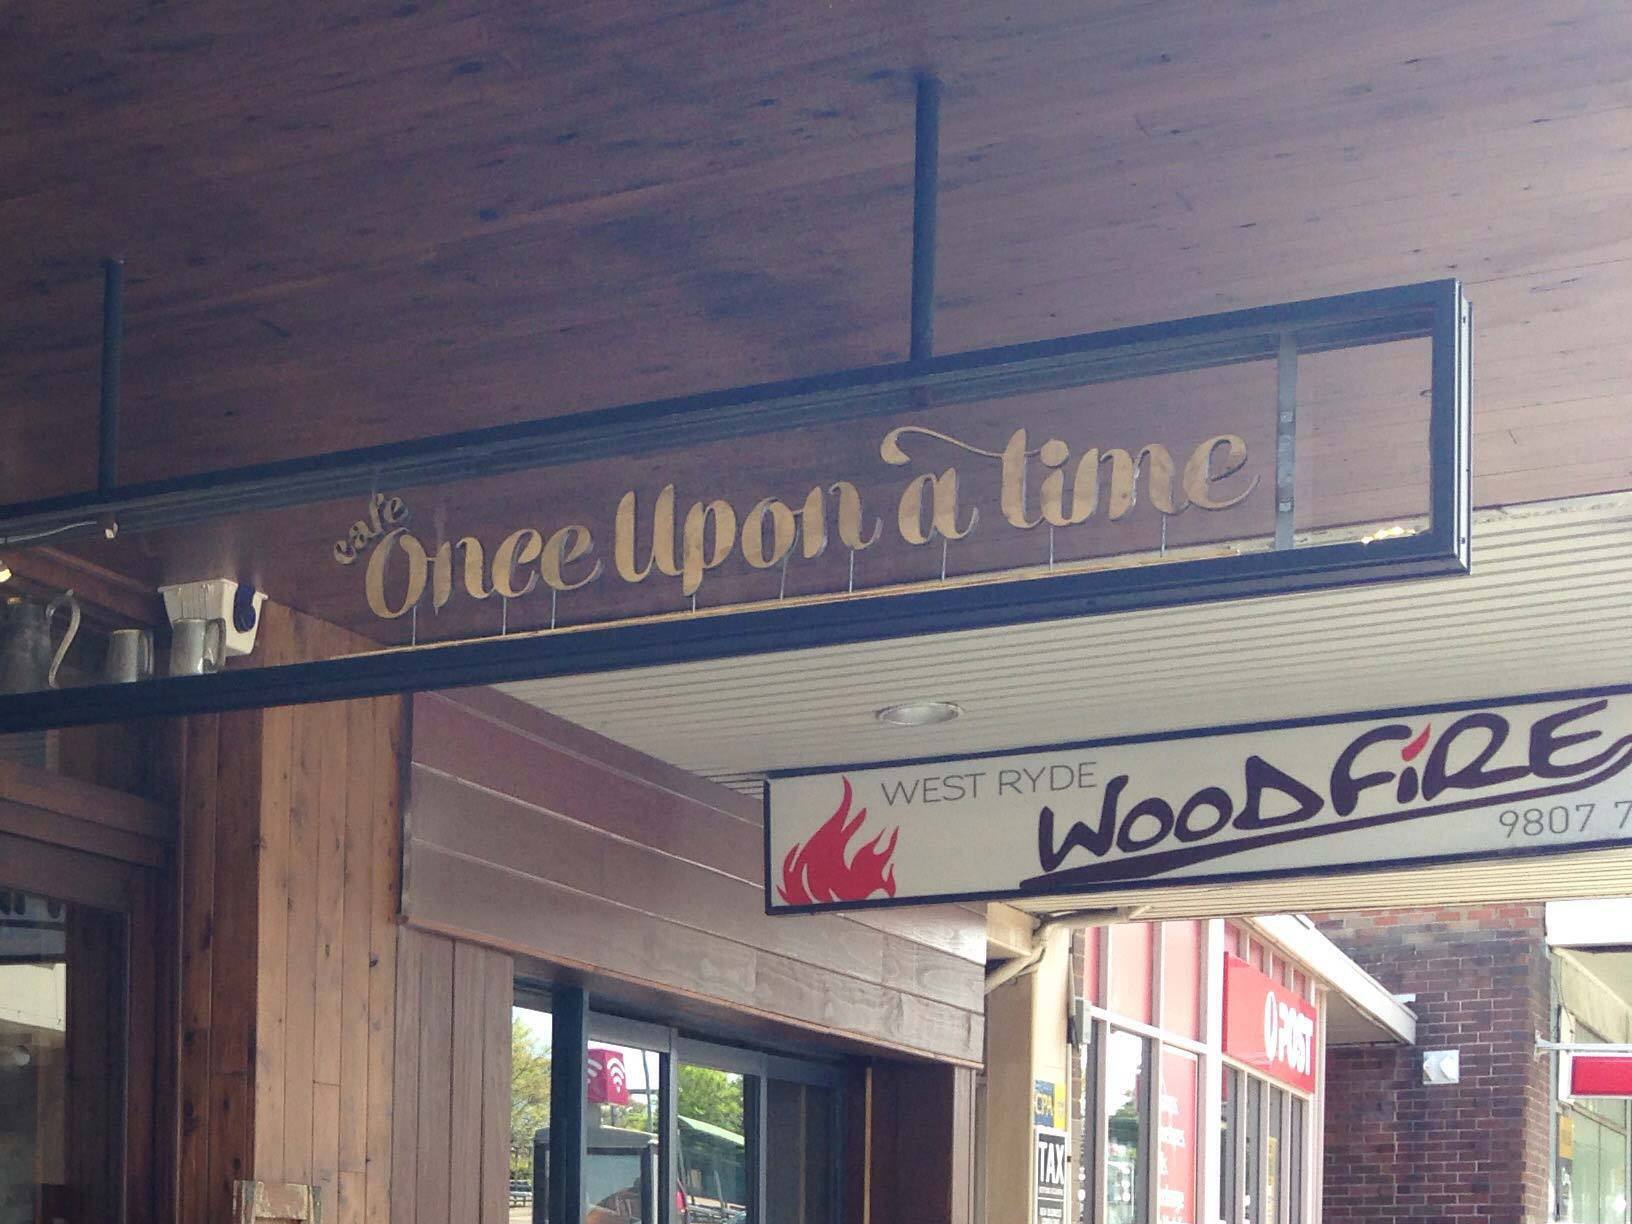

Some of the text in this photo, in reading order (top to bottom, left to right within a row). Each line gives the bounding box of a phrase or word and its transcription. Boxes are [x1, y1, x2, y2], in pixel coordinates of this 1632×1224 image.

[365, 425, 1260, 619] Once Upon a time
[880, 761, 1099, 807] WEST RYDE
[1499, 803, 1596, 839] 9807
[1278, 1002, 1314, 1076] POST
[1038, 1141, 1065, 1185] TAX
